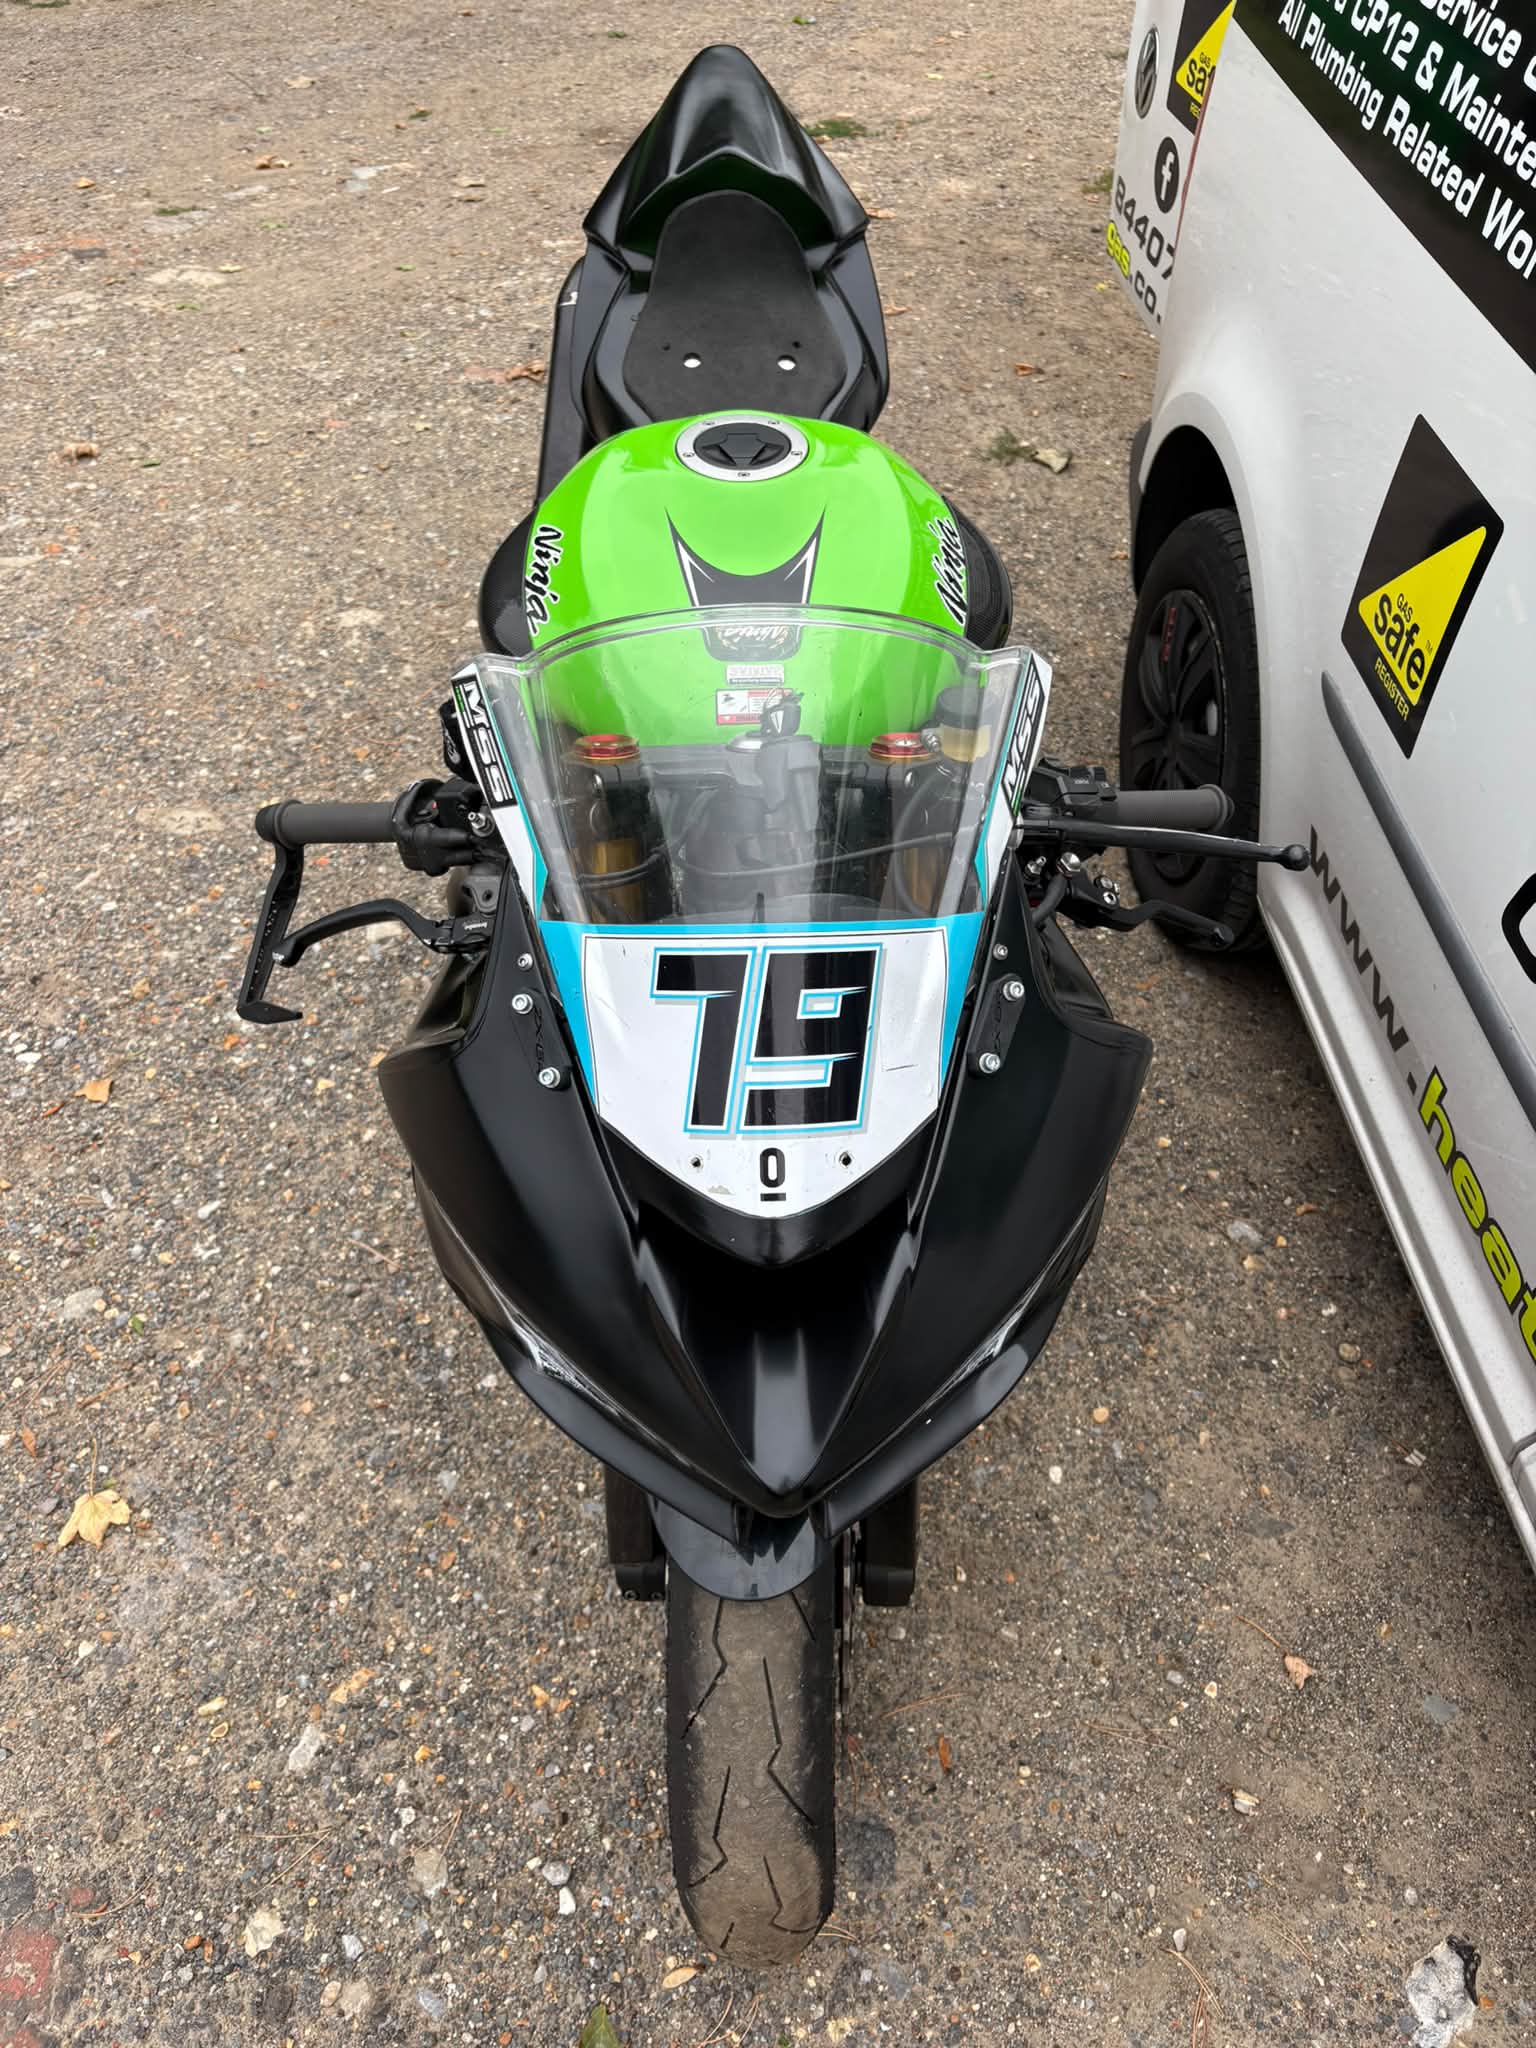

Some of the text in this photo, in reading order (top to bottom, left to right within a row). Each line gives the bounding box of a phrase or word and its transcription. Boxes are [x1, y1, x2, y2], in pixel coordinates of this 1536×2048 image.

[1350, 0, 1420, 71] CP12
[1414, 40, 1444, 94] &
[1277, 0, 1307, 40] All
[1300, 10, 1385, 131] Plumbing
[1382, 94, 1486, 218] Related
[524, 524, 564, 636] Ninja
[927, 517, 968, 626] Ninja
[1397, 593, 1413, 623] GAS
[1374, 593, 1425, 691] safe
[1374, 656, 1410, 721] REGISTER
[463, 680, 514, 803] MSS
